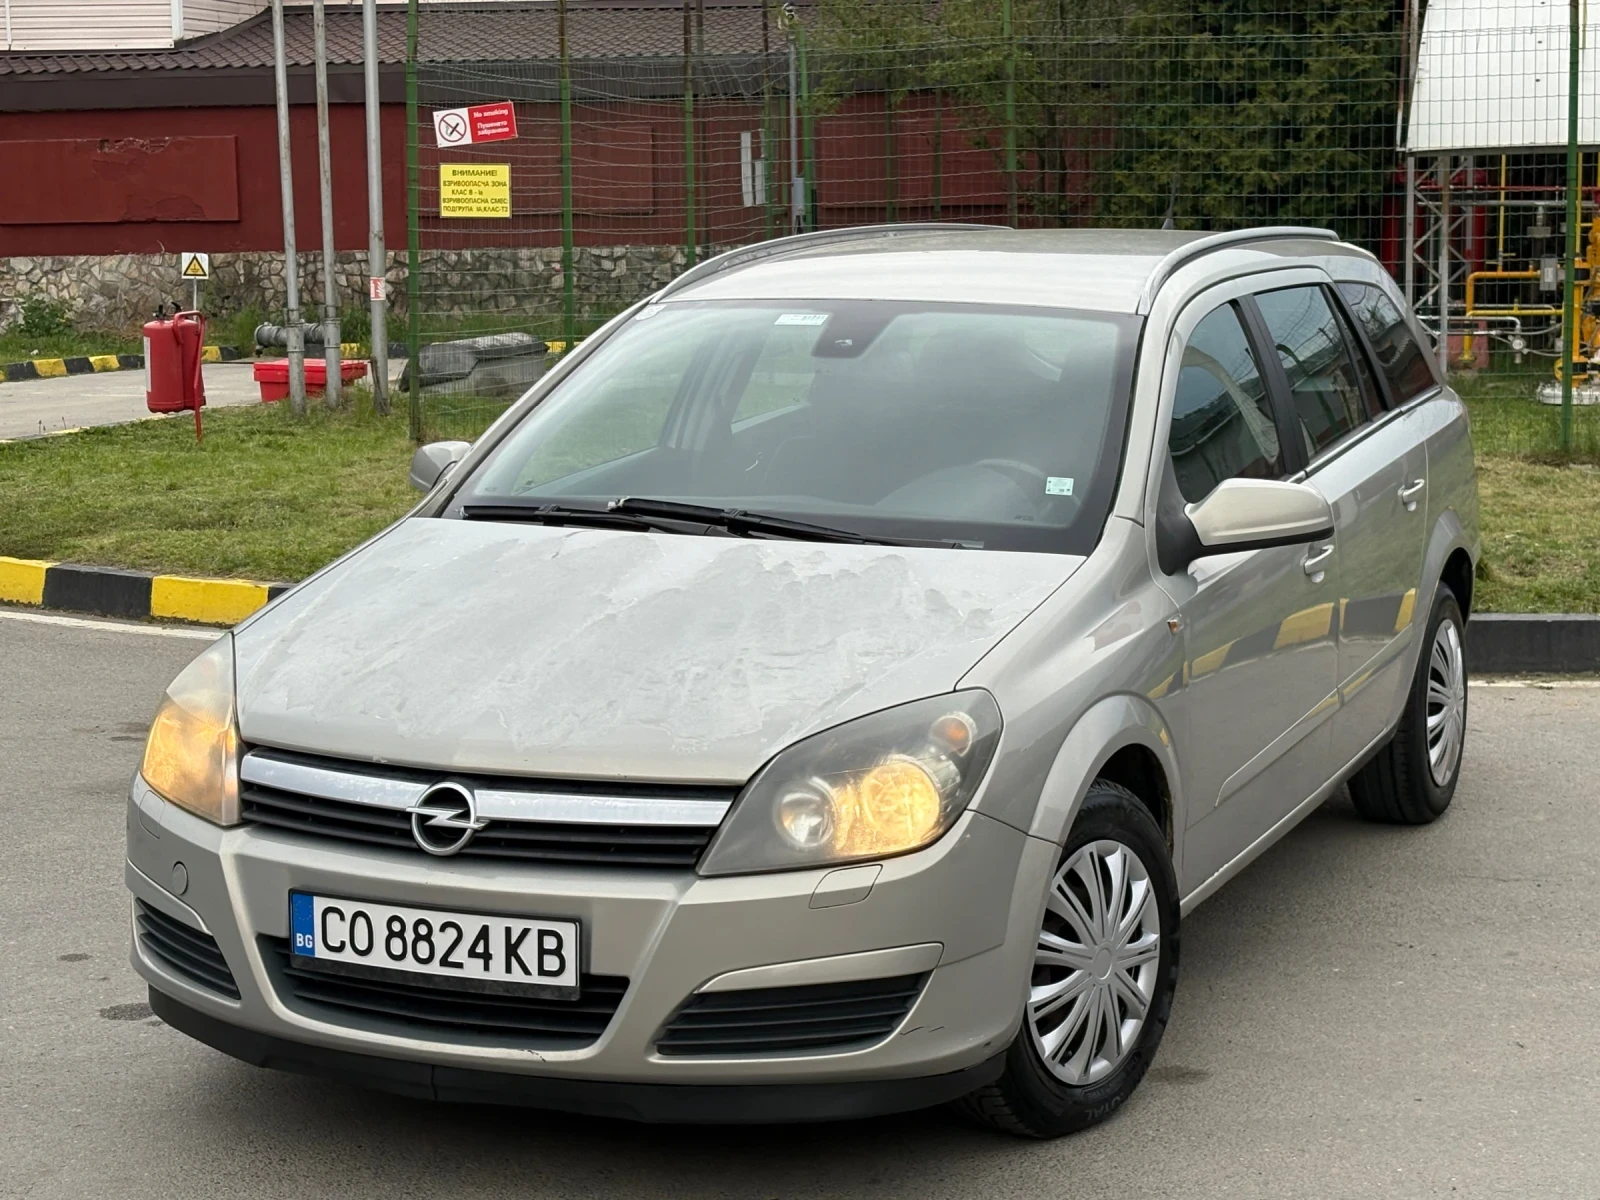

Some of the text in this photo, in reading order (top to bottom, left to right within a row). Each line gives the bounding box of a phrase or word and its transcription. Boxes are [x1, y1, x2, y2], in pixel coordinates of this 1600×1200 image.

[483, 109, 508, 118] smoking
[296, 933, 313, 949] BG
[385, 915, 493, 972] 8824
[505, 926, 566, 977] KB
